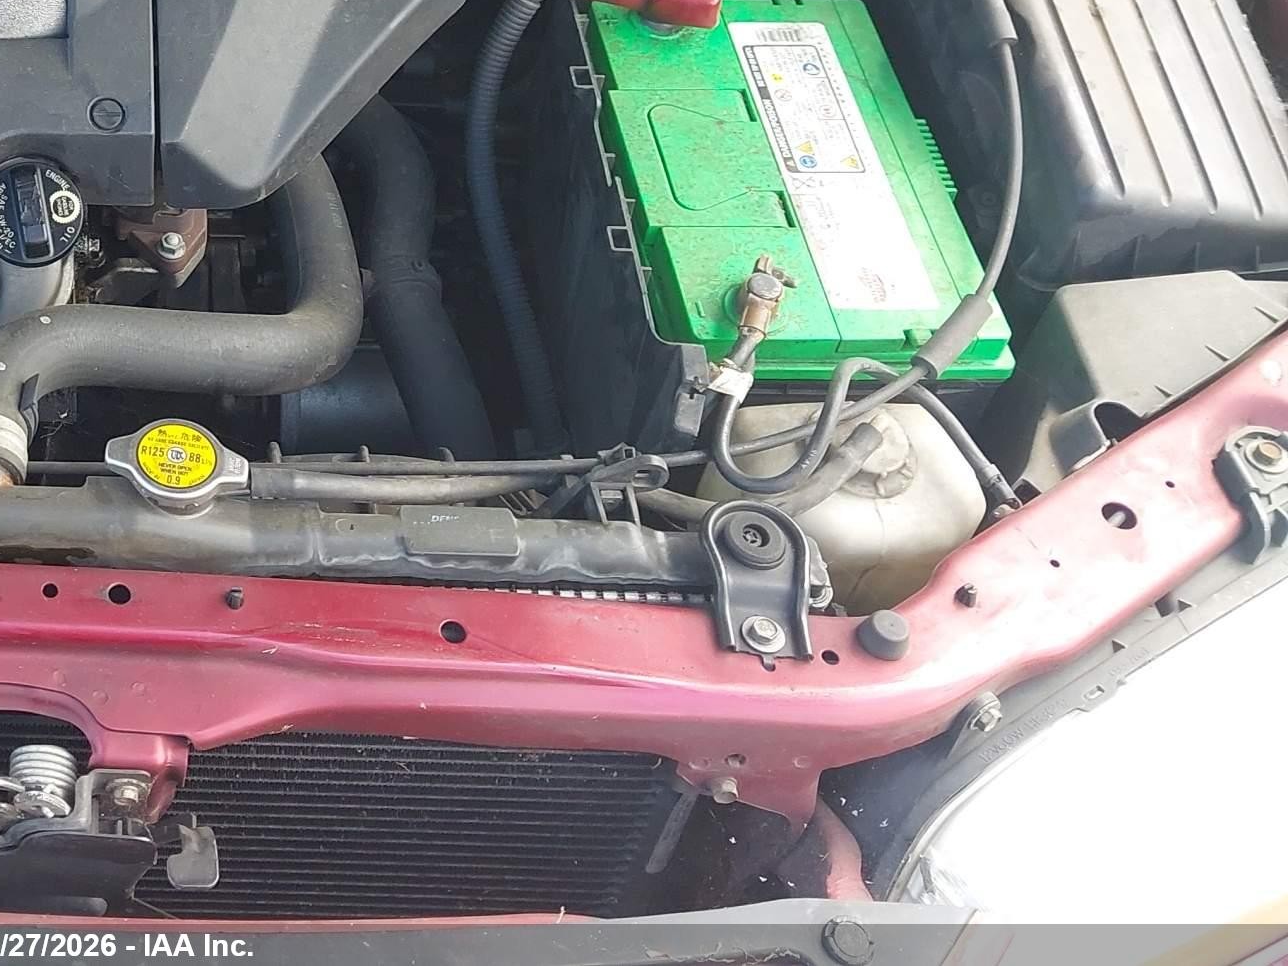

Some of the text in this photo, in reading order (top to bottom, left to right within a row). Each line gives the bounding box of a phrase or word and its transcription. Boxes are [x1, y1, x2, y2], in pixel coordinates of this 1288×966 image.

[45, 169, 76, 243] ENGINE OIL
[141, 445, 165, 457] R125
[166, 474, 181, 485] 0.9
